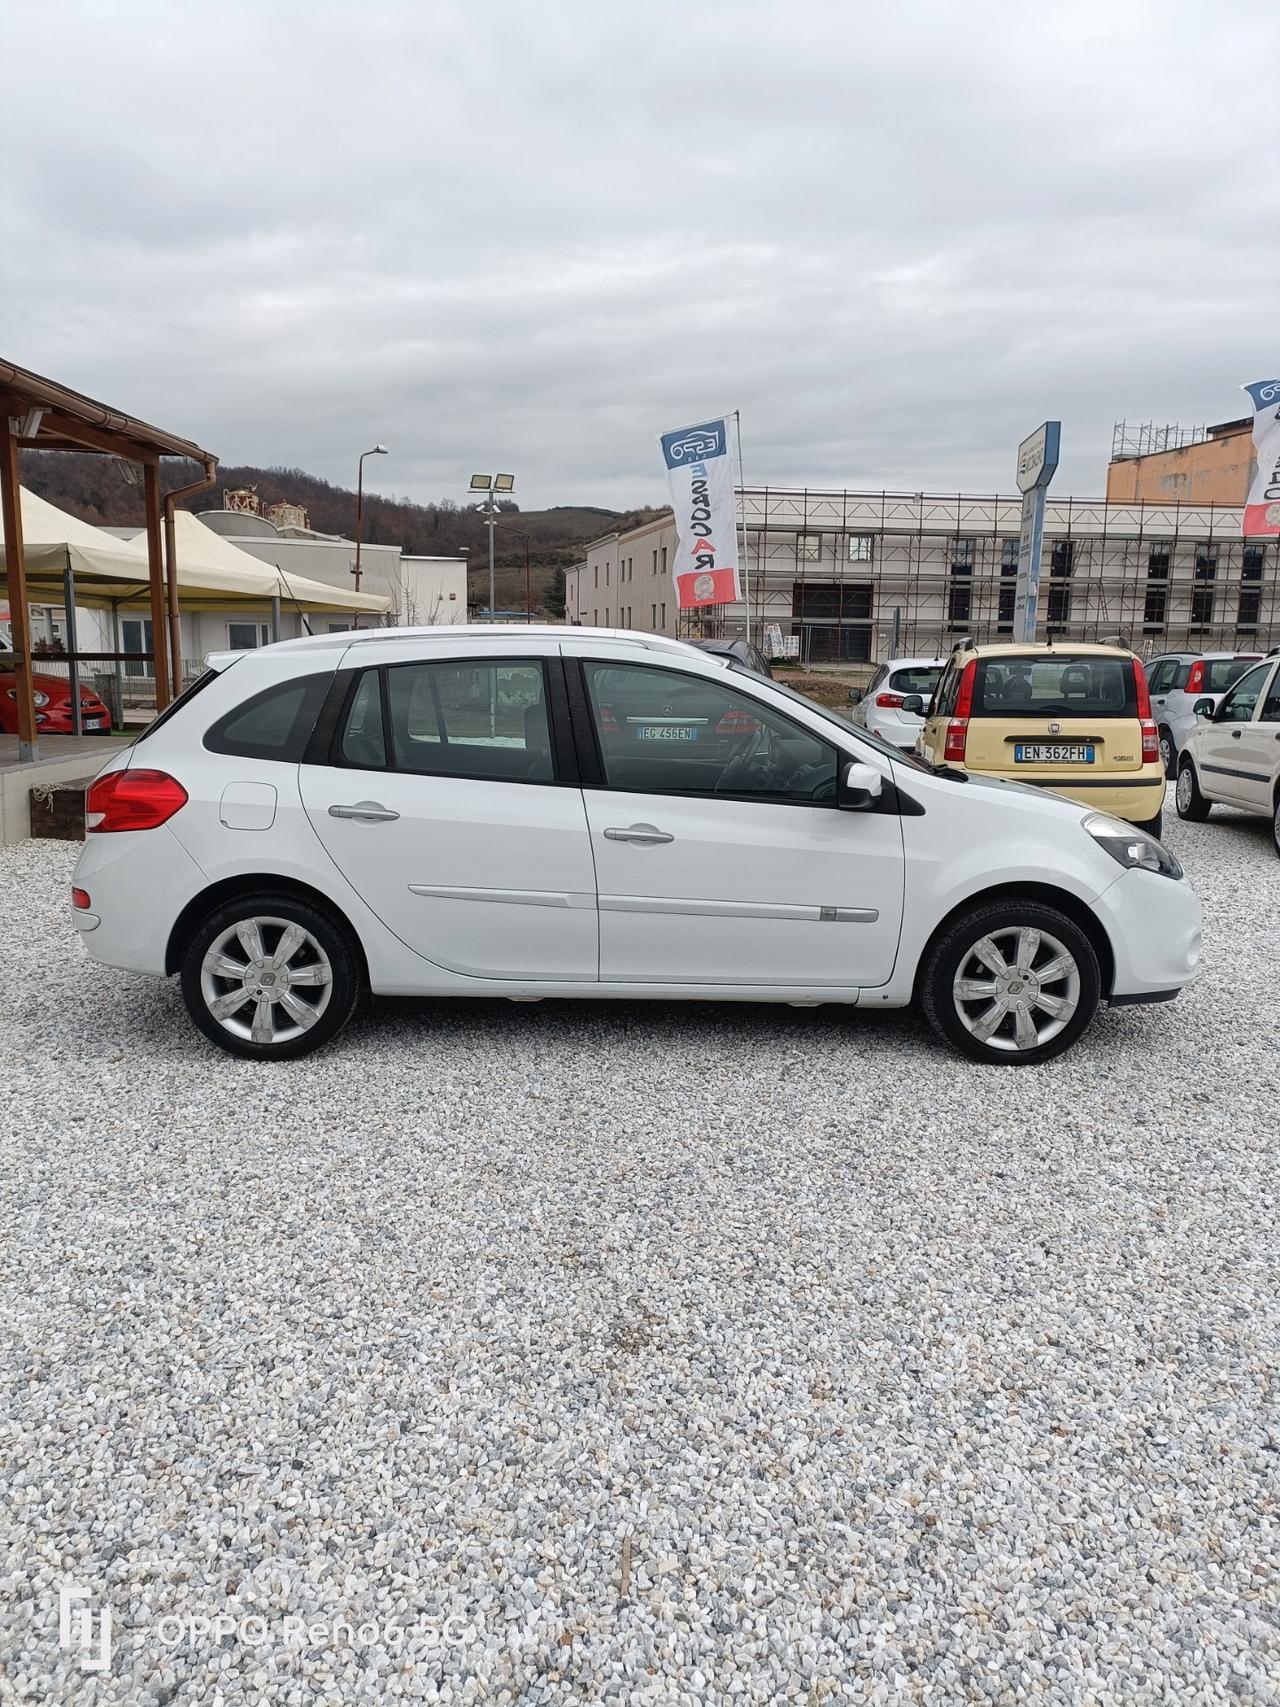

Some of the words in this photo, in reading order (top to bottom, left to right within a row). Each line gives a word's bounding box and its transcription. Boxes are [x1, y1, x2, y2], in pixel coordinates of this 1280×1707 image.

[644, 728, 656, 739] EG
[660, 728, 691, 739] 456EN
[1024, 746, 1041, 760] EN
[1044, 746, 1086, 760] 362FH
